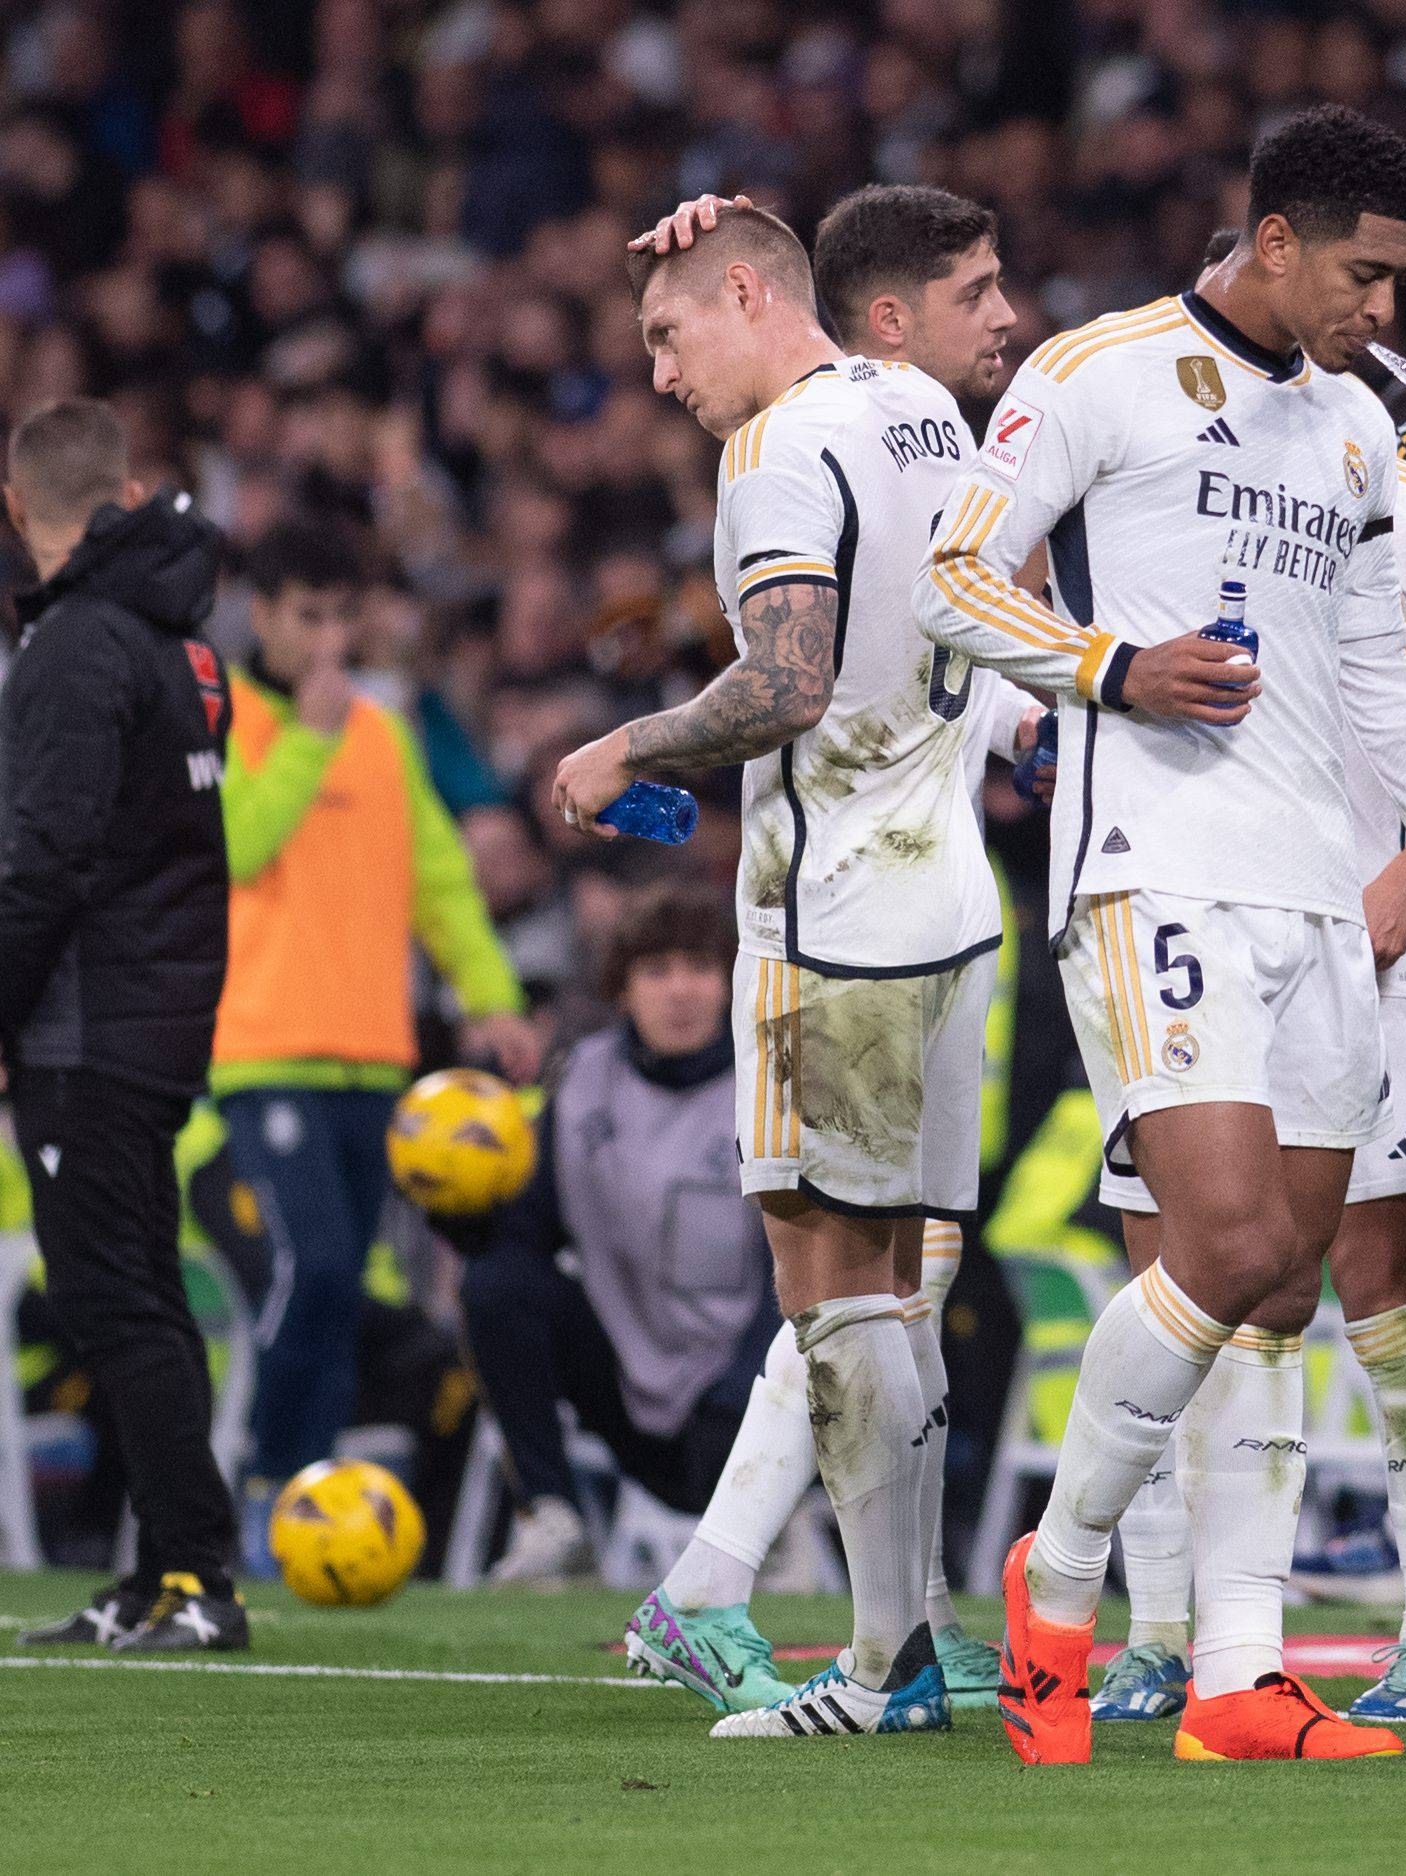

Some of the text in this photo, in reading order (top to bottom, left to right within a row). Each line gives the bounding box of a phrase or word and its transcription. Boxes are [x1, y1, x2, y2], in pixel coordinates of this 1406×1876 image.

[881, 418, 960, 473] KROOS
[1197, 470, 1357, 560] Emirates
[1273, 539, 1337, 596] BETTER
[1154, 922, 1204, 1010] 5
